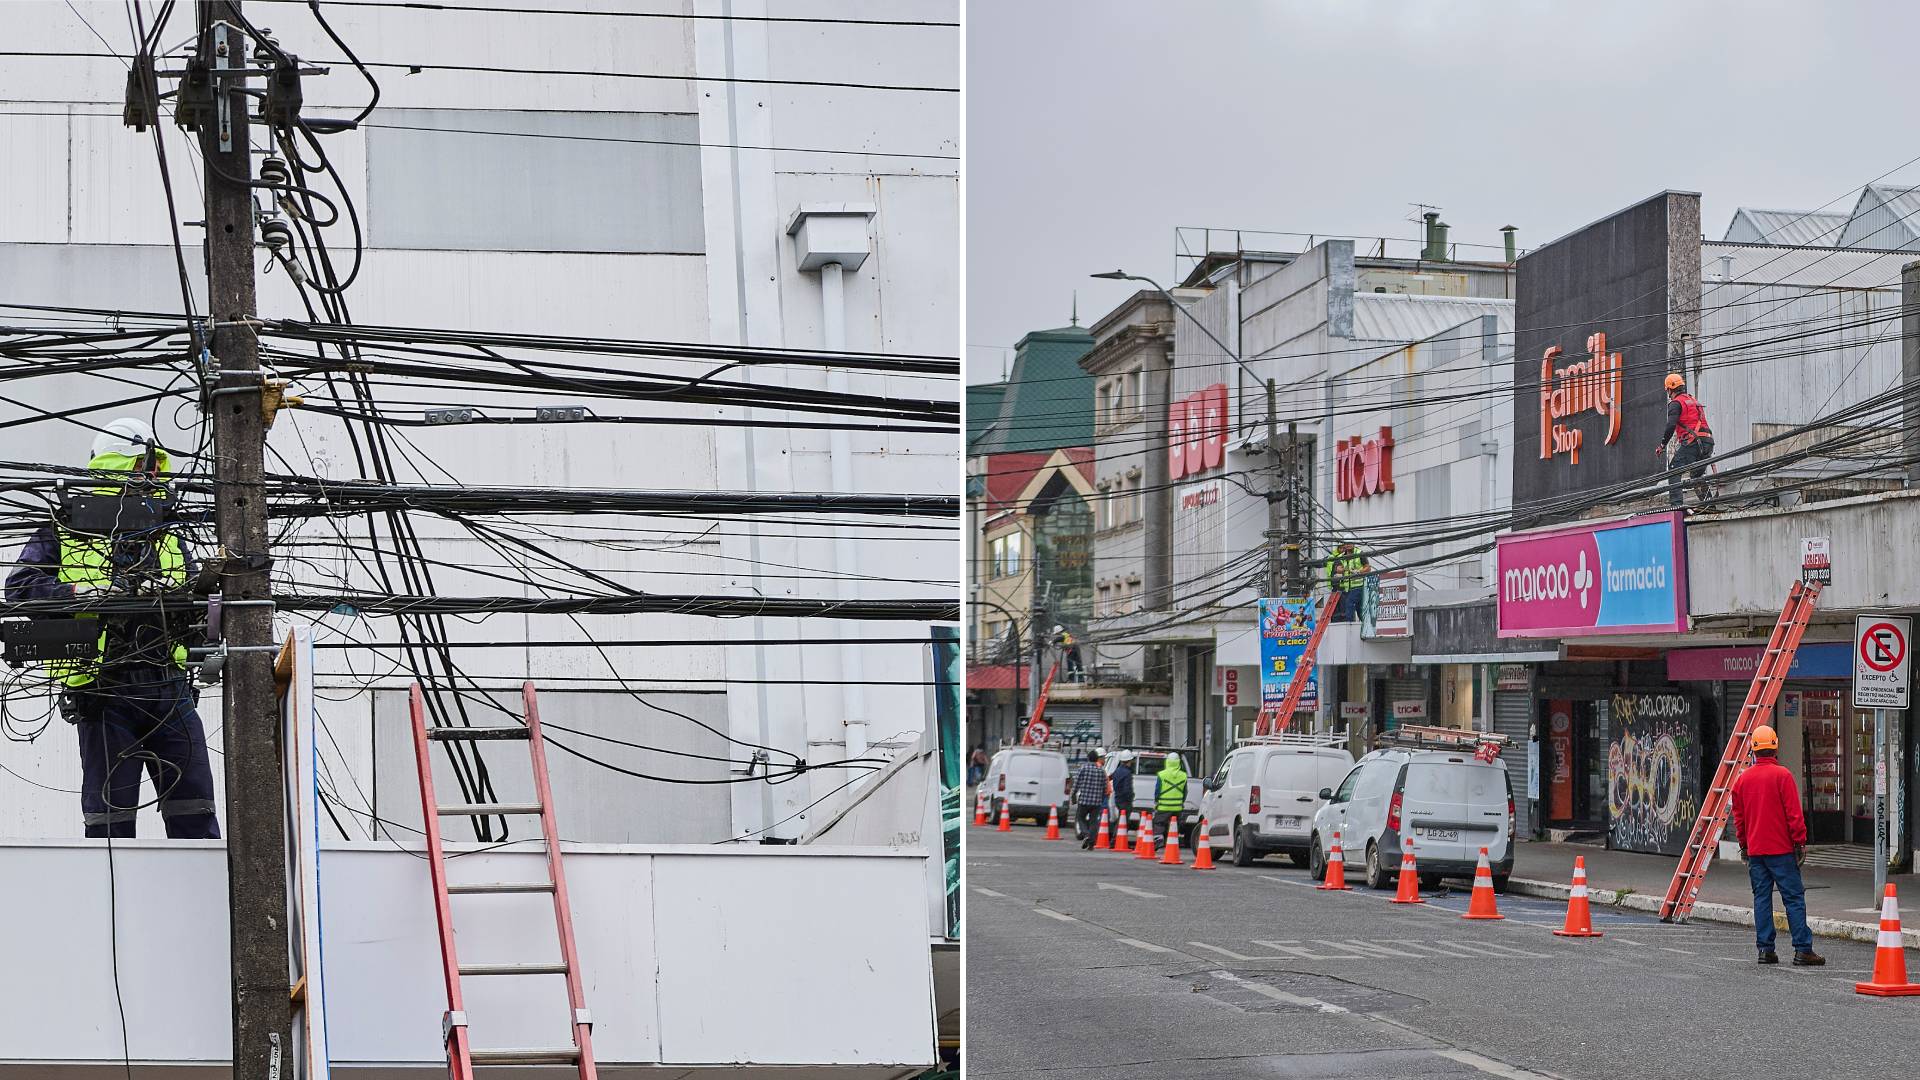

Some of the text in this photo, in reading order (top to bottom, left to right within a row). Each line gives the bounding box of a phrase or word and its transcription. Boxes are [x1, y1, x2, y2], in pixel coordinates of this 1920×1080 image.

[1540, 332, 1622, 460] family
[1553, 424, 1582, 465] Shop
[1505, 556, 1665, 602] maicao farmacia
[1724, 657, 1753, 671] maicao
[1861, 674, 1886, 682] EXCEPTO
[1345, 706, 1368, 714] tricot
[1398, 705, 1422, 714] tricot
